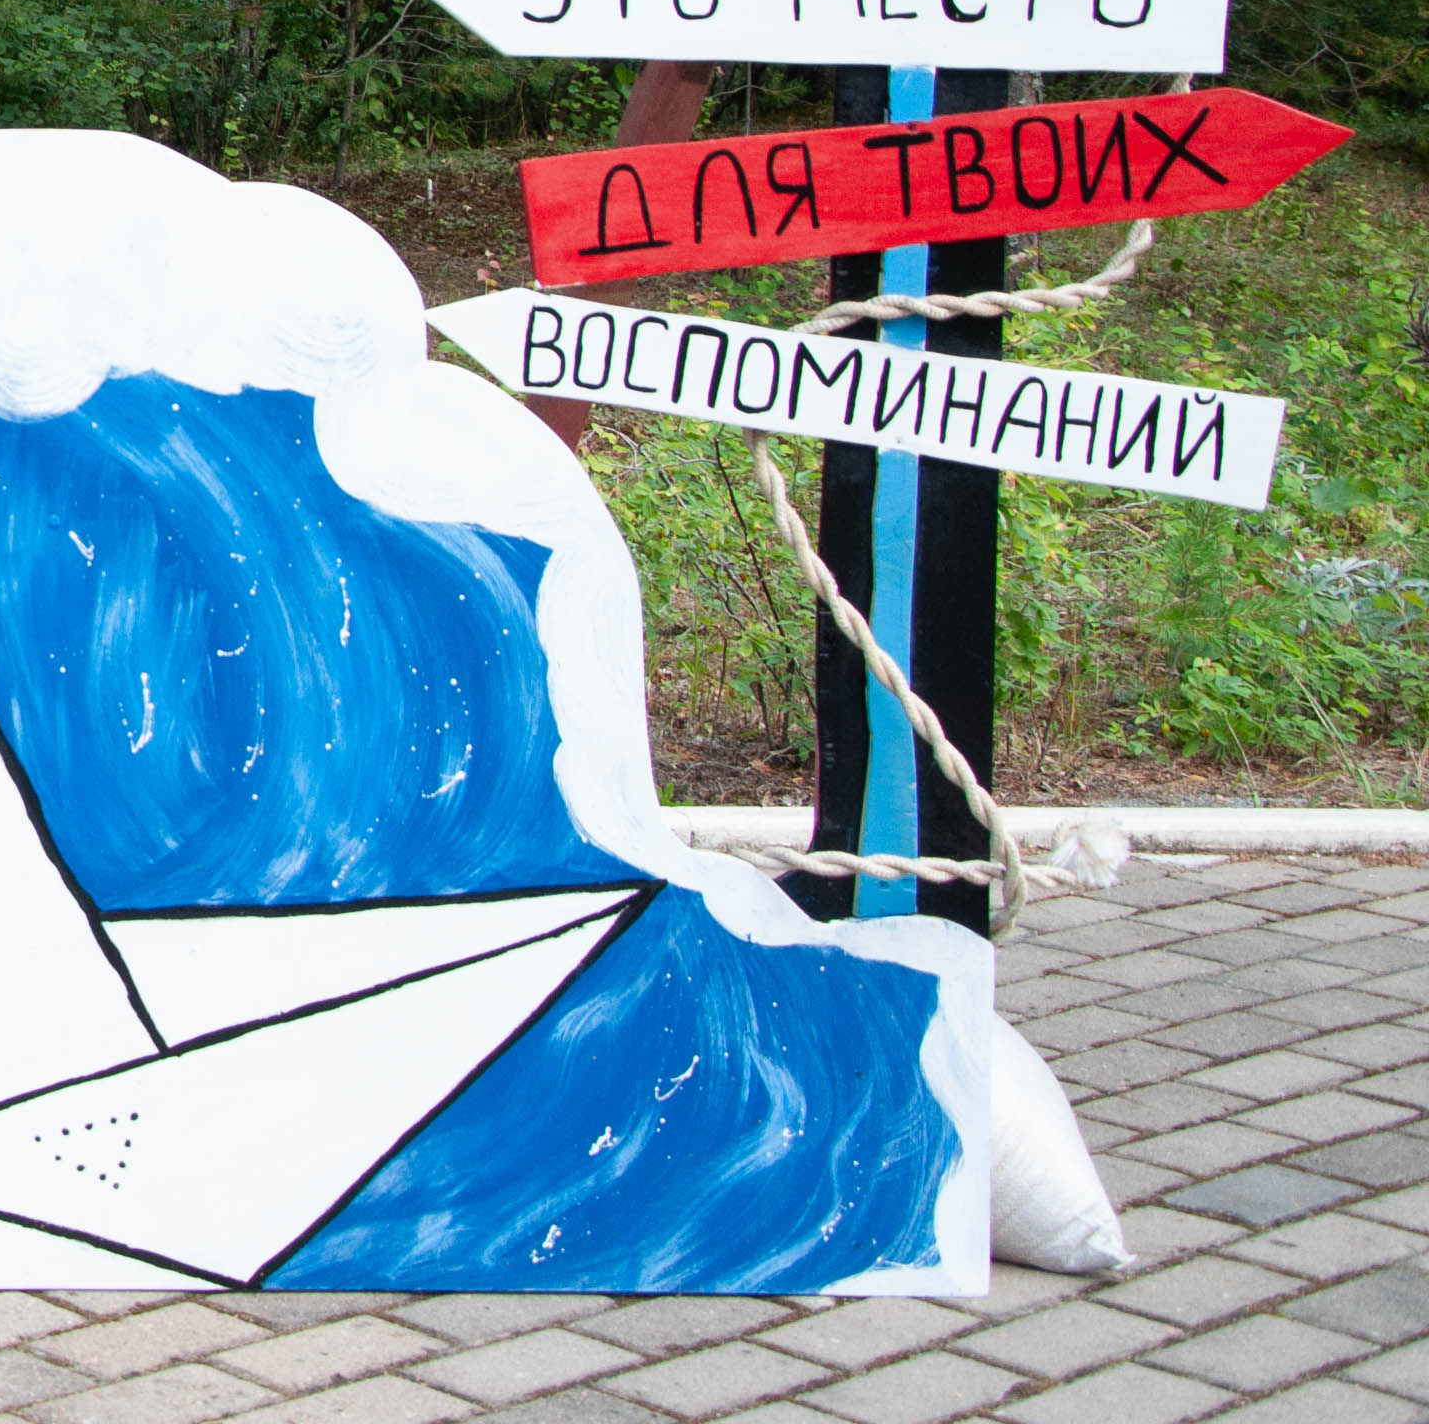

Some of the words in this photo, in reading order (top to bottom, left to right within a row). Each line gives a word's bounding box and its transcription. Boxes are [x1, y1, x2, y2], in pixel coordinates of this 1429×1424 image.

[580, 142, 821, 256] ДЛЯ
[864, 107, 1230, 218] ТВОИХ
[523, 305, 1224, 481] ВОСПОМИНАНИЙ
